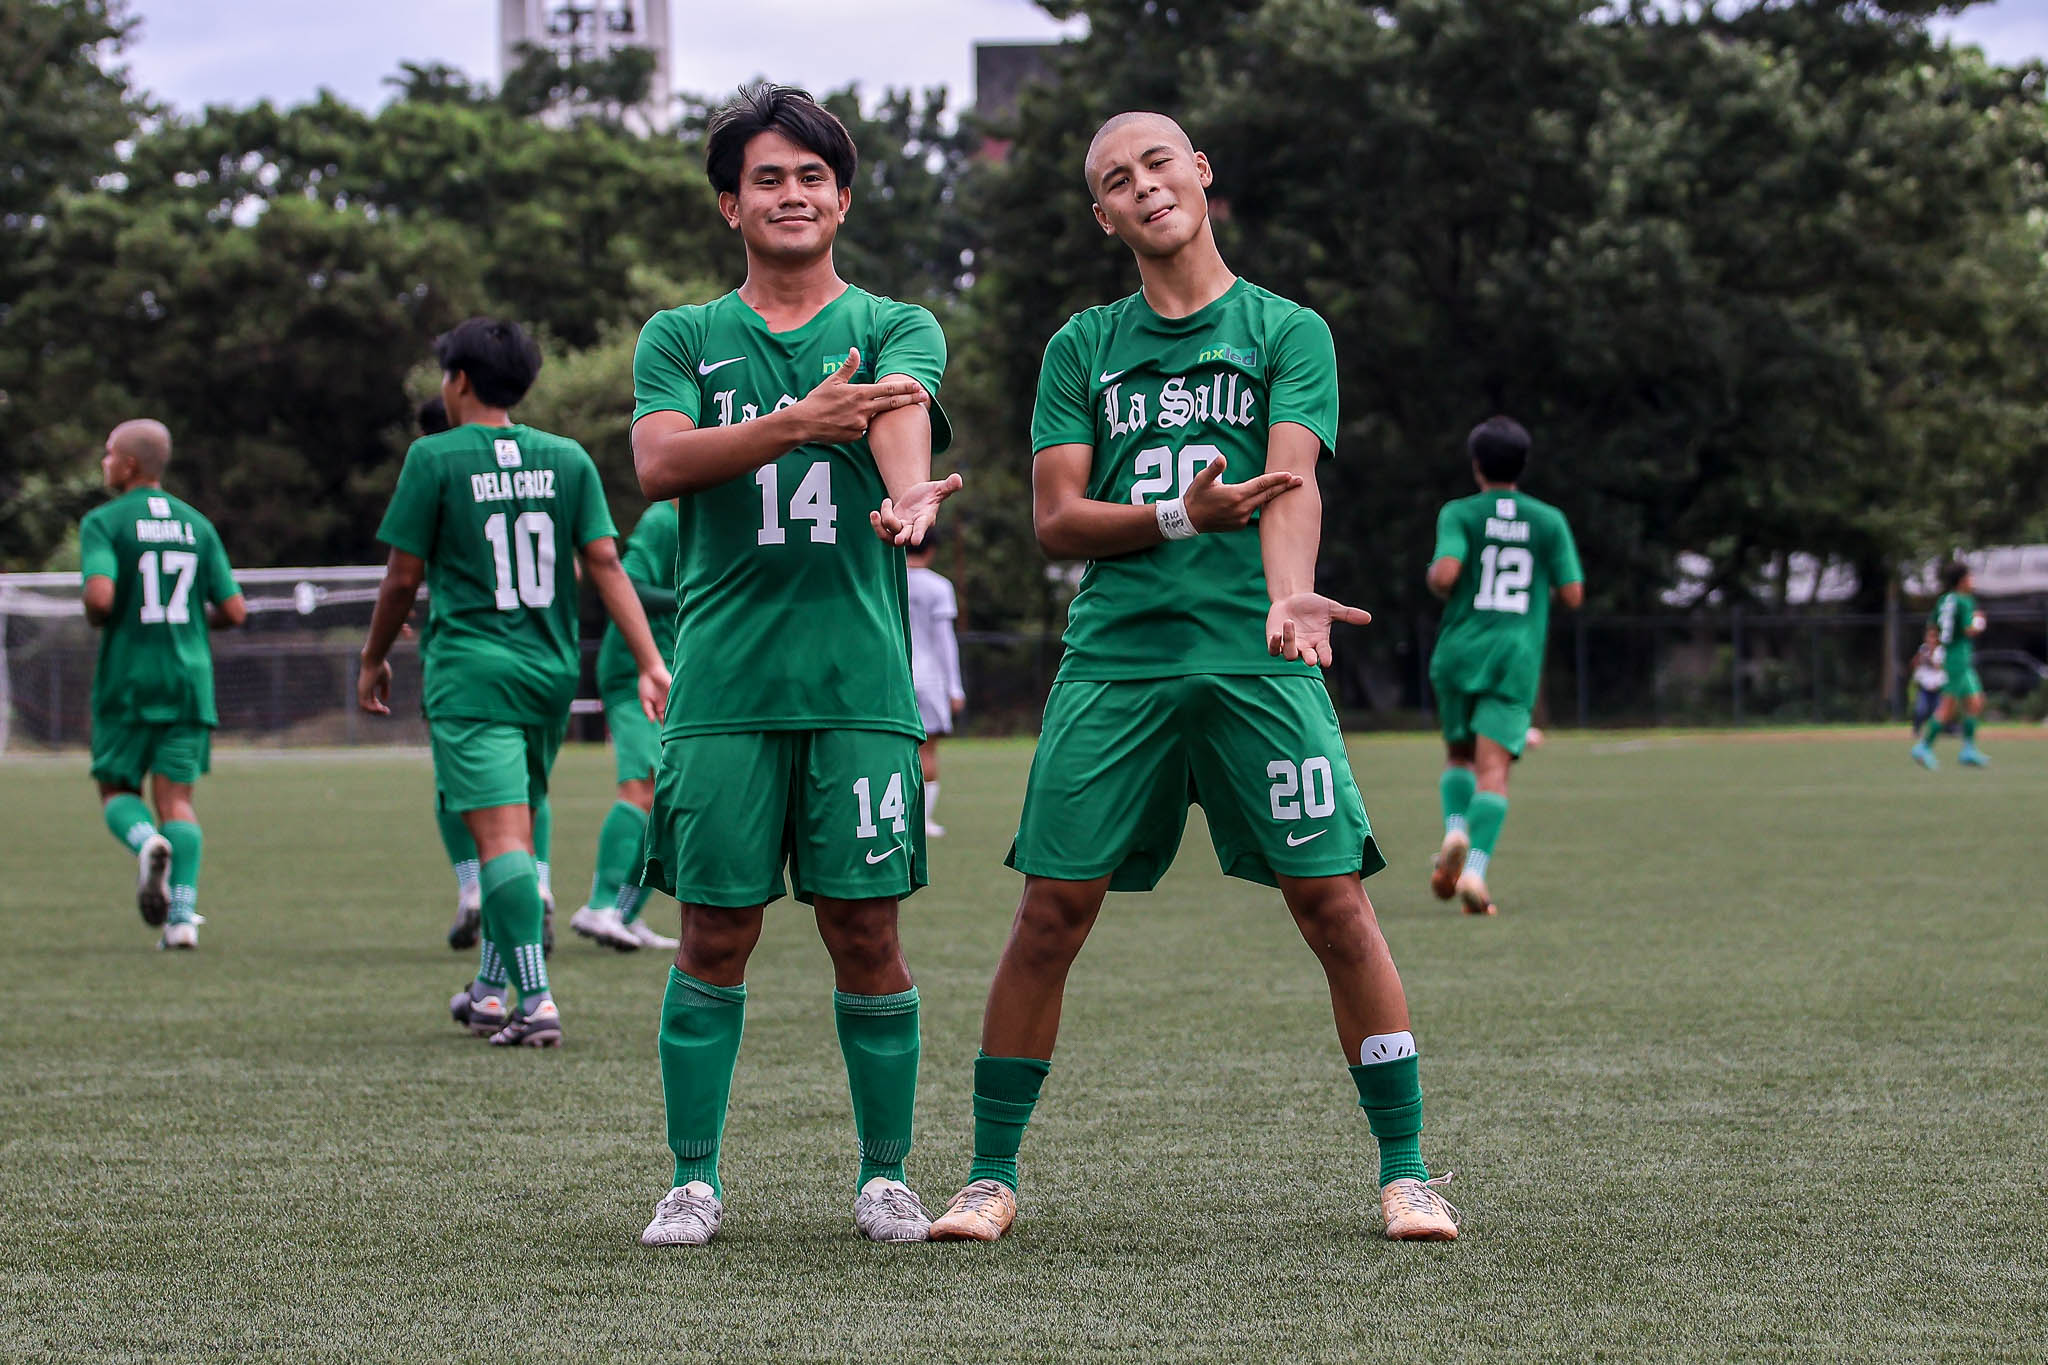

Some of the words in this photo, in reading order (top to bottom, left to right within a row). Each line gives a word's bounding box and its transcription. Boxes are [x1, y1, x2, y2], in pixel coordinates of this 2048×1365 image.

[1199, 347, 1256, 366] nxled
[1103, 382, 1147, 440] La
[1157, 372, 1255, 429] Salle
[513, 470, 556, 499] CRUZ
[756, 462, 837, 545] 14
[138, 550, 198, 624] 17
[485, 512, 556, 610] 10
[1474, 544, 1534, 615] 12
[853, 772, 906, 838] 14
[1267, 756, 1336, 819] 20
